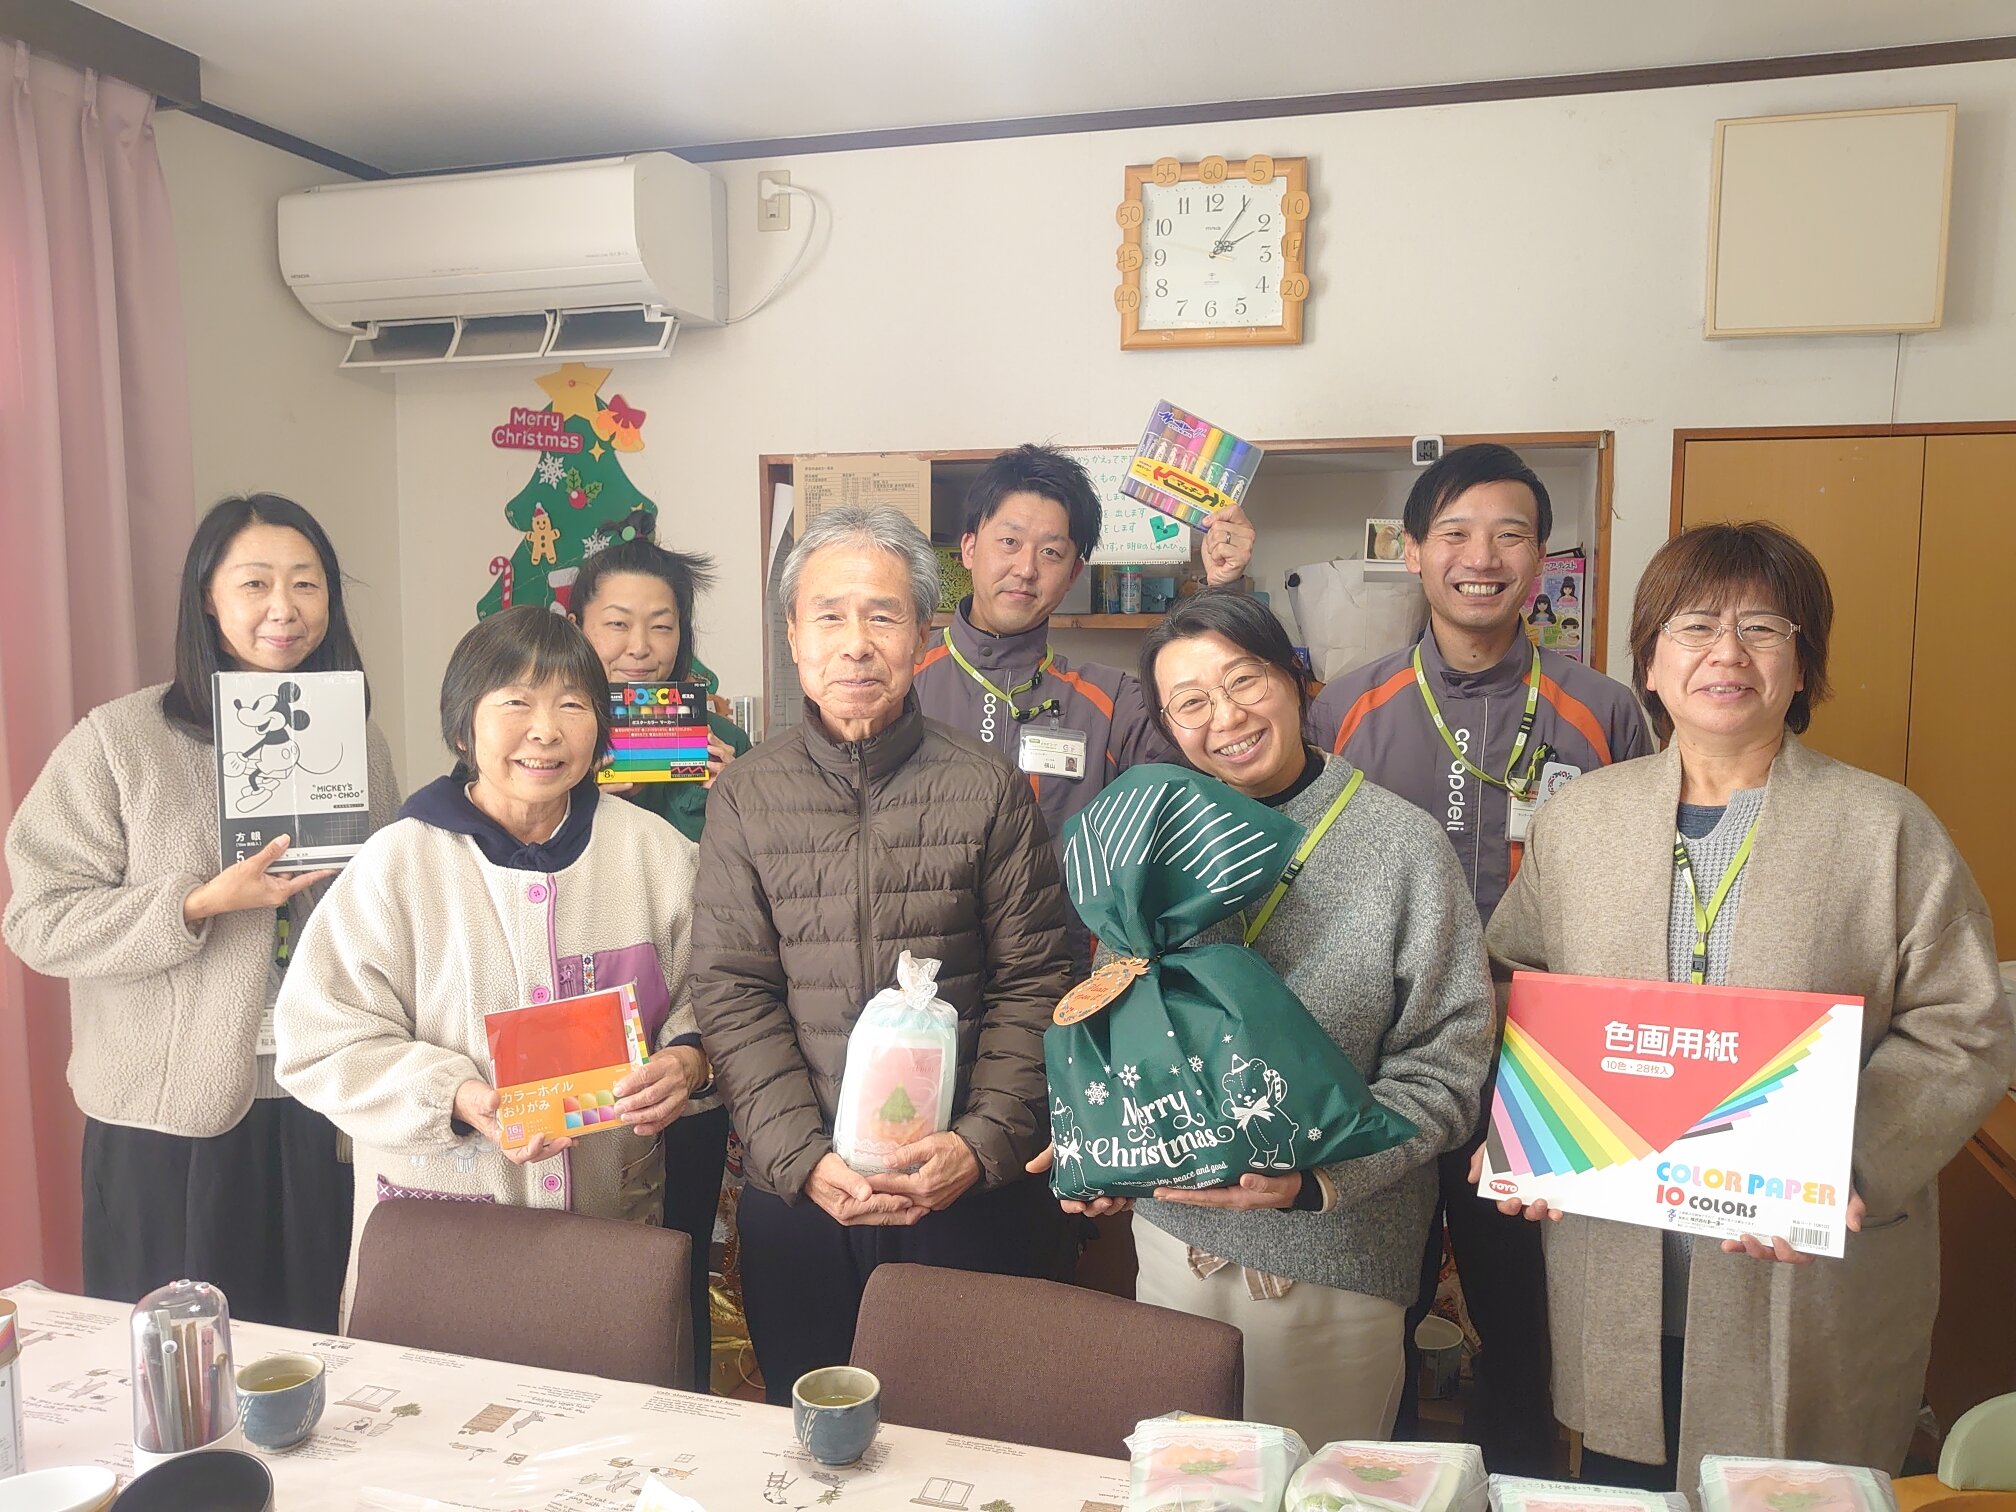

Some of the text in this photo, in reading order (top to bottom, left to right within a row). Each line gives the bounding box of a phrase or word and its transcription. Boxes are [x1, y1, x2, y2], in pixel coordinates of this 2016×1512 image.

[1156, 163, 1177, 183] 55
[1203, 162, 1223, 180] 60
[1252, 161, 1266, 182] 5
[1179, 197, 1190, 214] 11
[1206, 194, 1224, 212] 12
[1286, 198, 1304, 215] 10
[1119, 206, 1141, 223] 50
[1258, 214, 1271, 232] 2
[1156, 219, 1172, 236] 10
[1118, 249, 1138, 267] 45
[1154, 249, 1167, 266] 9
[1259, 246, 1272, 263] 3
[1155, 279, 1168, 297] 8
[1255, 276, 1269, 293] 4
[1283, 279, 1305, 298] 20
[1117, 293, 1138, 308] 40
[1176, 300, 1188, 317] 7
[1204, 300, 1217, 318] 6
[1235, 297, 1248, 315] 5
[514, 411, 560, 431] Merry
[494, 429, 579, 449] Christmas
[1176, 479, 1202, 496] マッキー
[623, 688, 682, 705] POSCA
[1604, 1020, 1740, 1064] 色画用紙
[502, 1081, 574, 1105] カラーホイル
[503, 1100, 551, 1119] おりがみ
[1122, 1089, 1204, 1142] Merry
[1086, 1126, 1235, 1168] Christmas
[1172, 1170, 1196, 1183] peace
[1196, 1165, 1210, 1176] and
[1210, 1161, 1228, 1174] good
[1490, 1181, 1518, 1194] TOYO
[1656, 1161, 1836, 1207] COLOR PAPER
[1656, 1184, 1758, 1219] 10 COLORS
